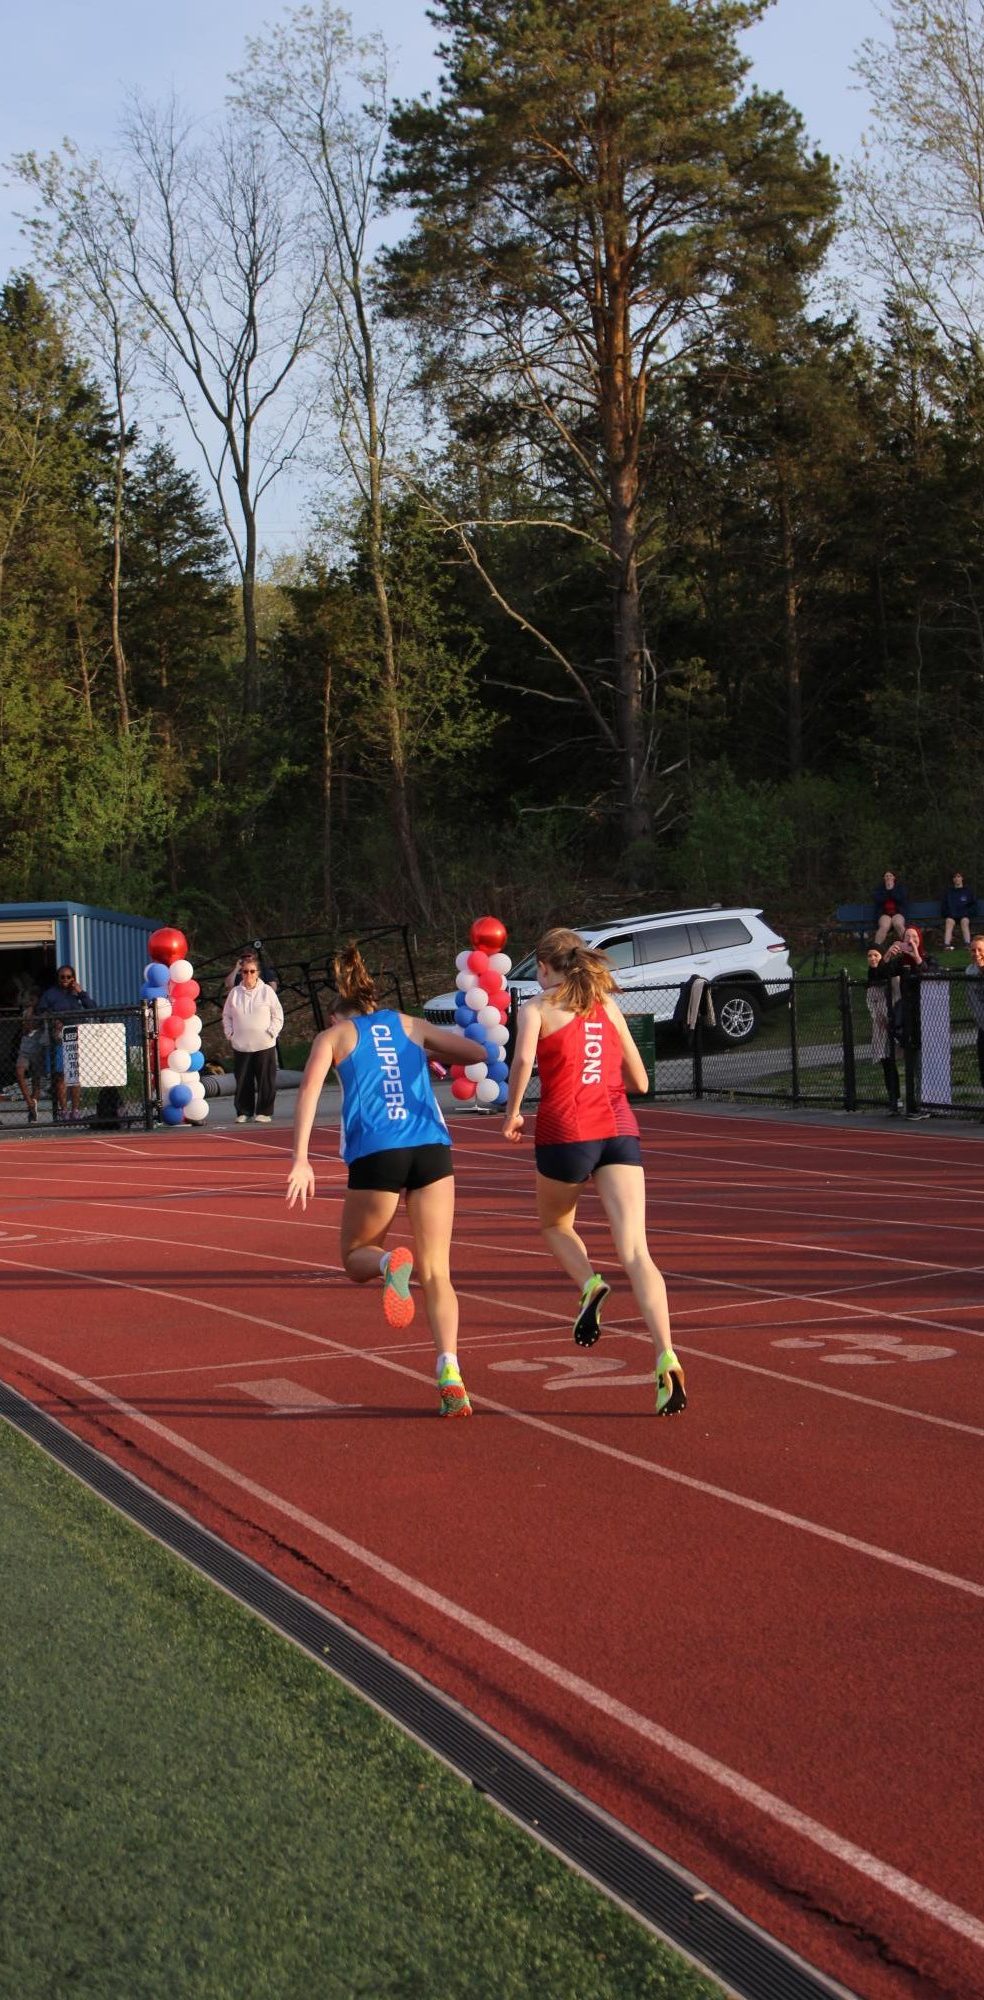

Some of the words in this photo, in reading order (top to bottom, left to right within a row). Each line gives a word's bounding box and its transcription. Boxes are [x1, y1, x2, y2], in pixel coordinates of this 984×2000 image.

[371, 1024, 407, 1120] CLIPPERS
[582, 1022, 602, 1084] LIONS
[770, 1333, 957, 1362] 3
[487, 1356, 657, 1390] 2
